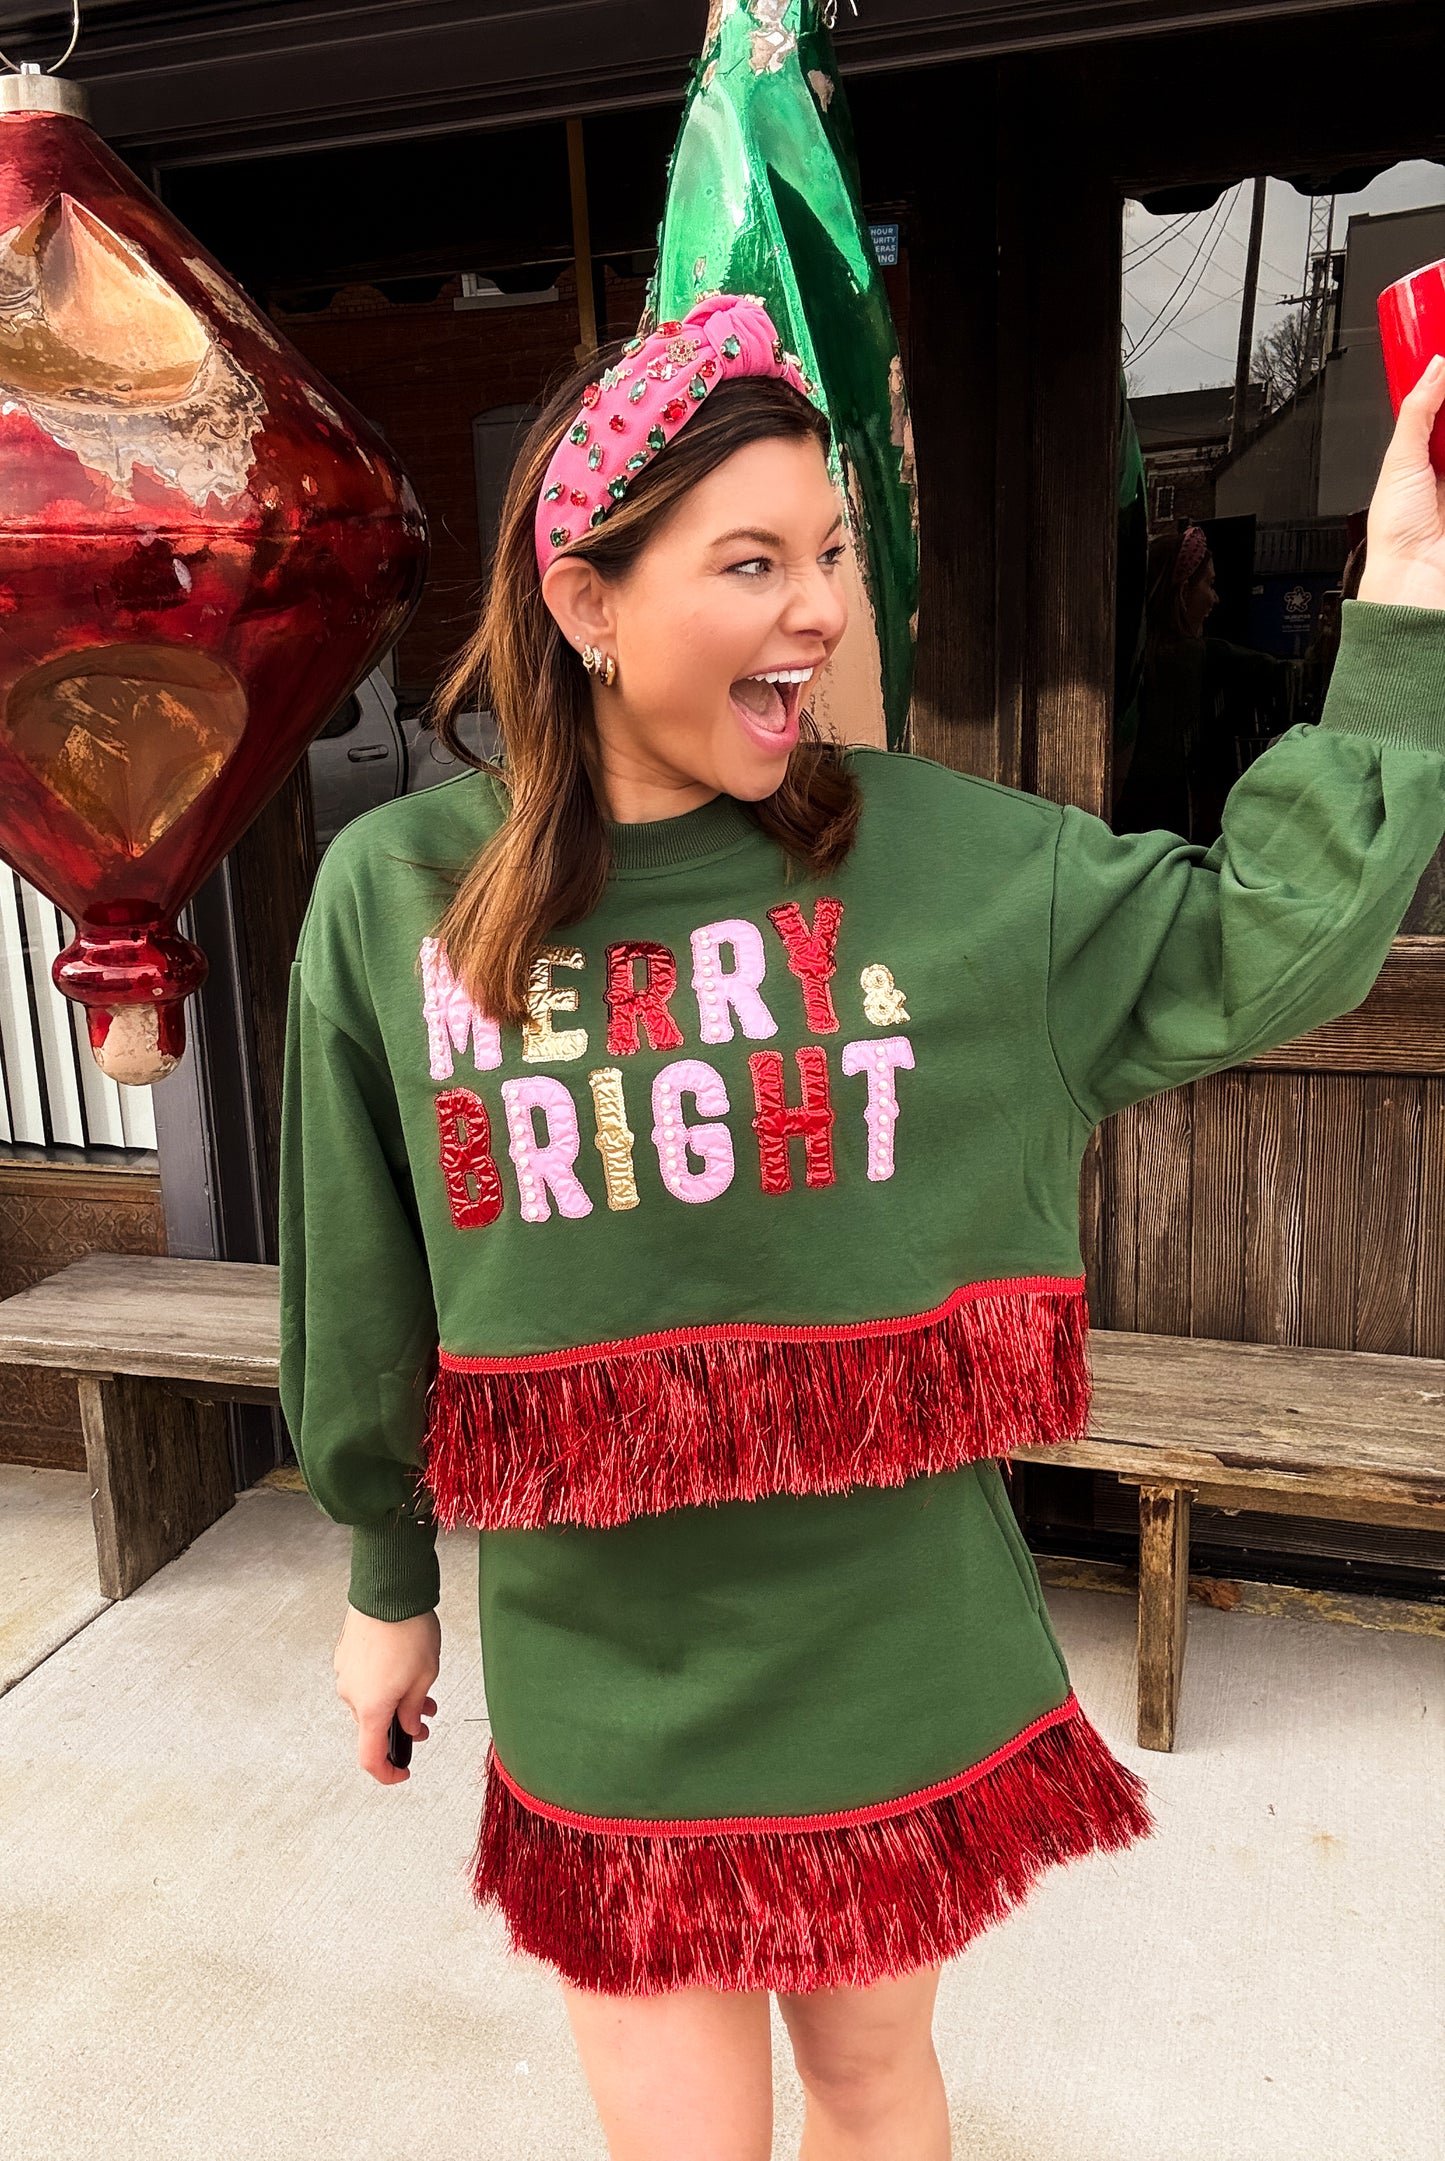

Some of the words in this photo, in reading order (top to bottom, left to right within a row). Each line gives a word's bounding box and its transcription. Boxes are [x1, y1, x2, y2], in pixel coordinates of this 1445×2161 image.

[870, 228, 893, 236] HOUR
[872, 236, 896, 244] URITY
[875, 244, 896, 253] ERAS
[877, 254, 895, 263] ING
[419, 896, 845, 1081] MERRY
[859, 963, 912, 1026] &
[433, 1035, 917, 1231] BRIGHT
